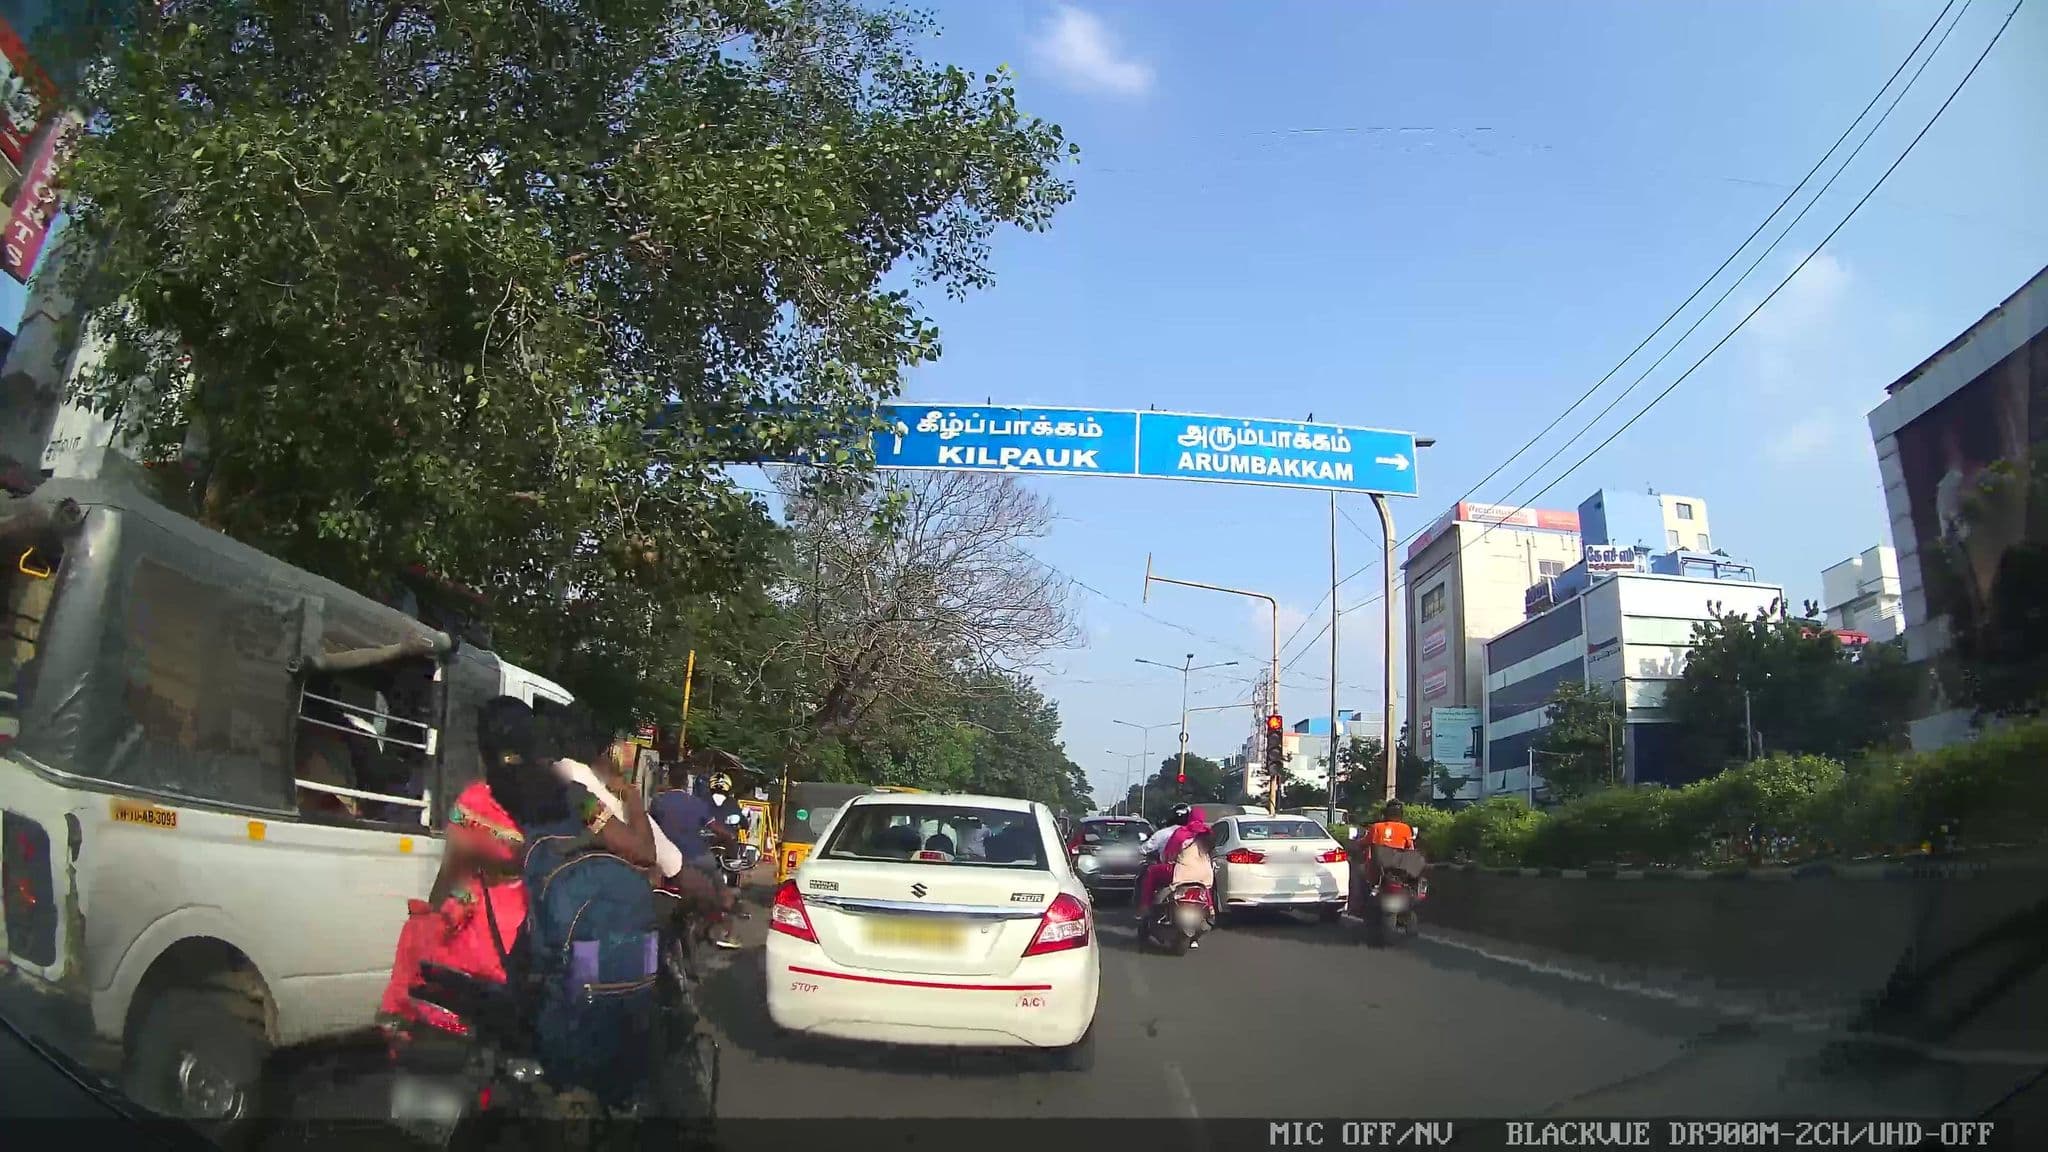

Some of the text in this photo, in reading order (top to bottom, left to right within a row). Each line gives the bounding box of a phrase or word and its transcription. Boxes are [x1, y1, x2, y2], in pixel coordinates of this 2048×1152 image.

[917, 411, 1103, 440] கீழ்ப்பாக்கம்
[1178, 422, 1351, 453] அரும்பாக்கம்
[938, 446, 1098, 468] KILPAUK
[1178, 452, 1354, 481] ARUMBAKKAM
[1013, 894, 1043, 902] TOUR
[791, 982, 818, 992] STOP
